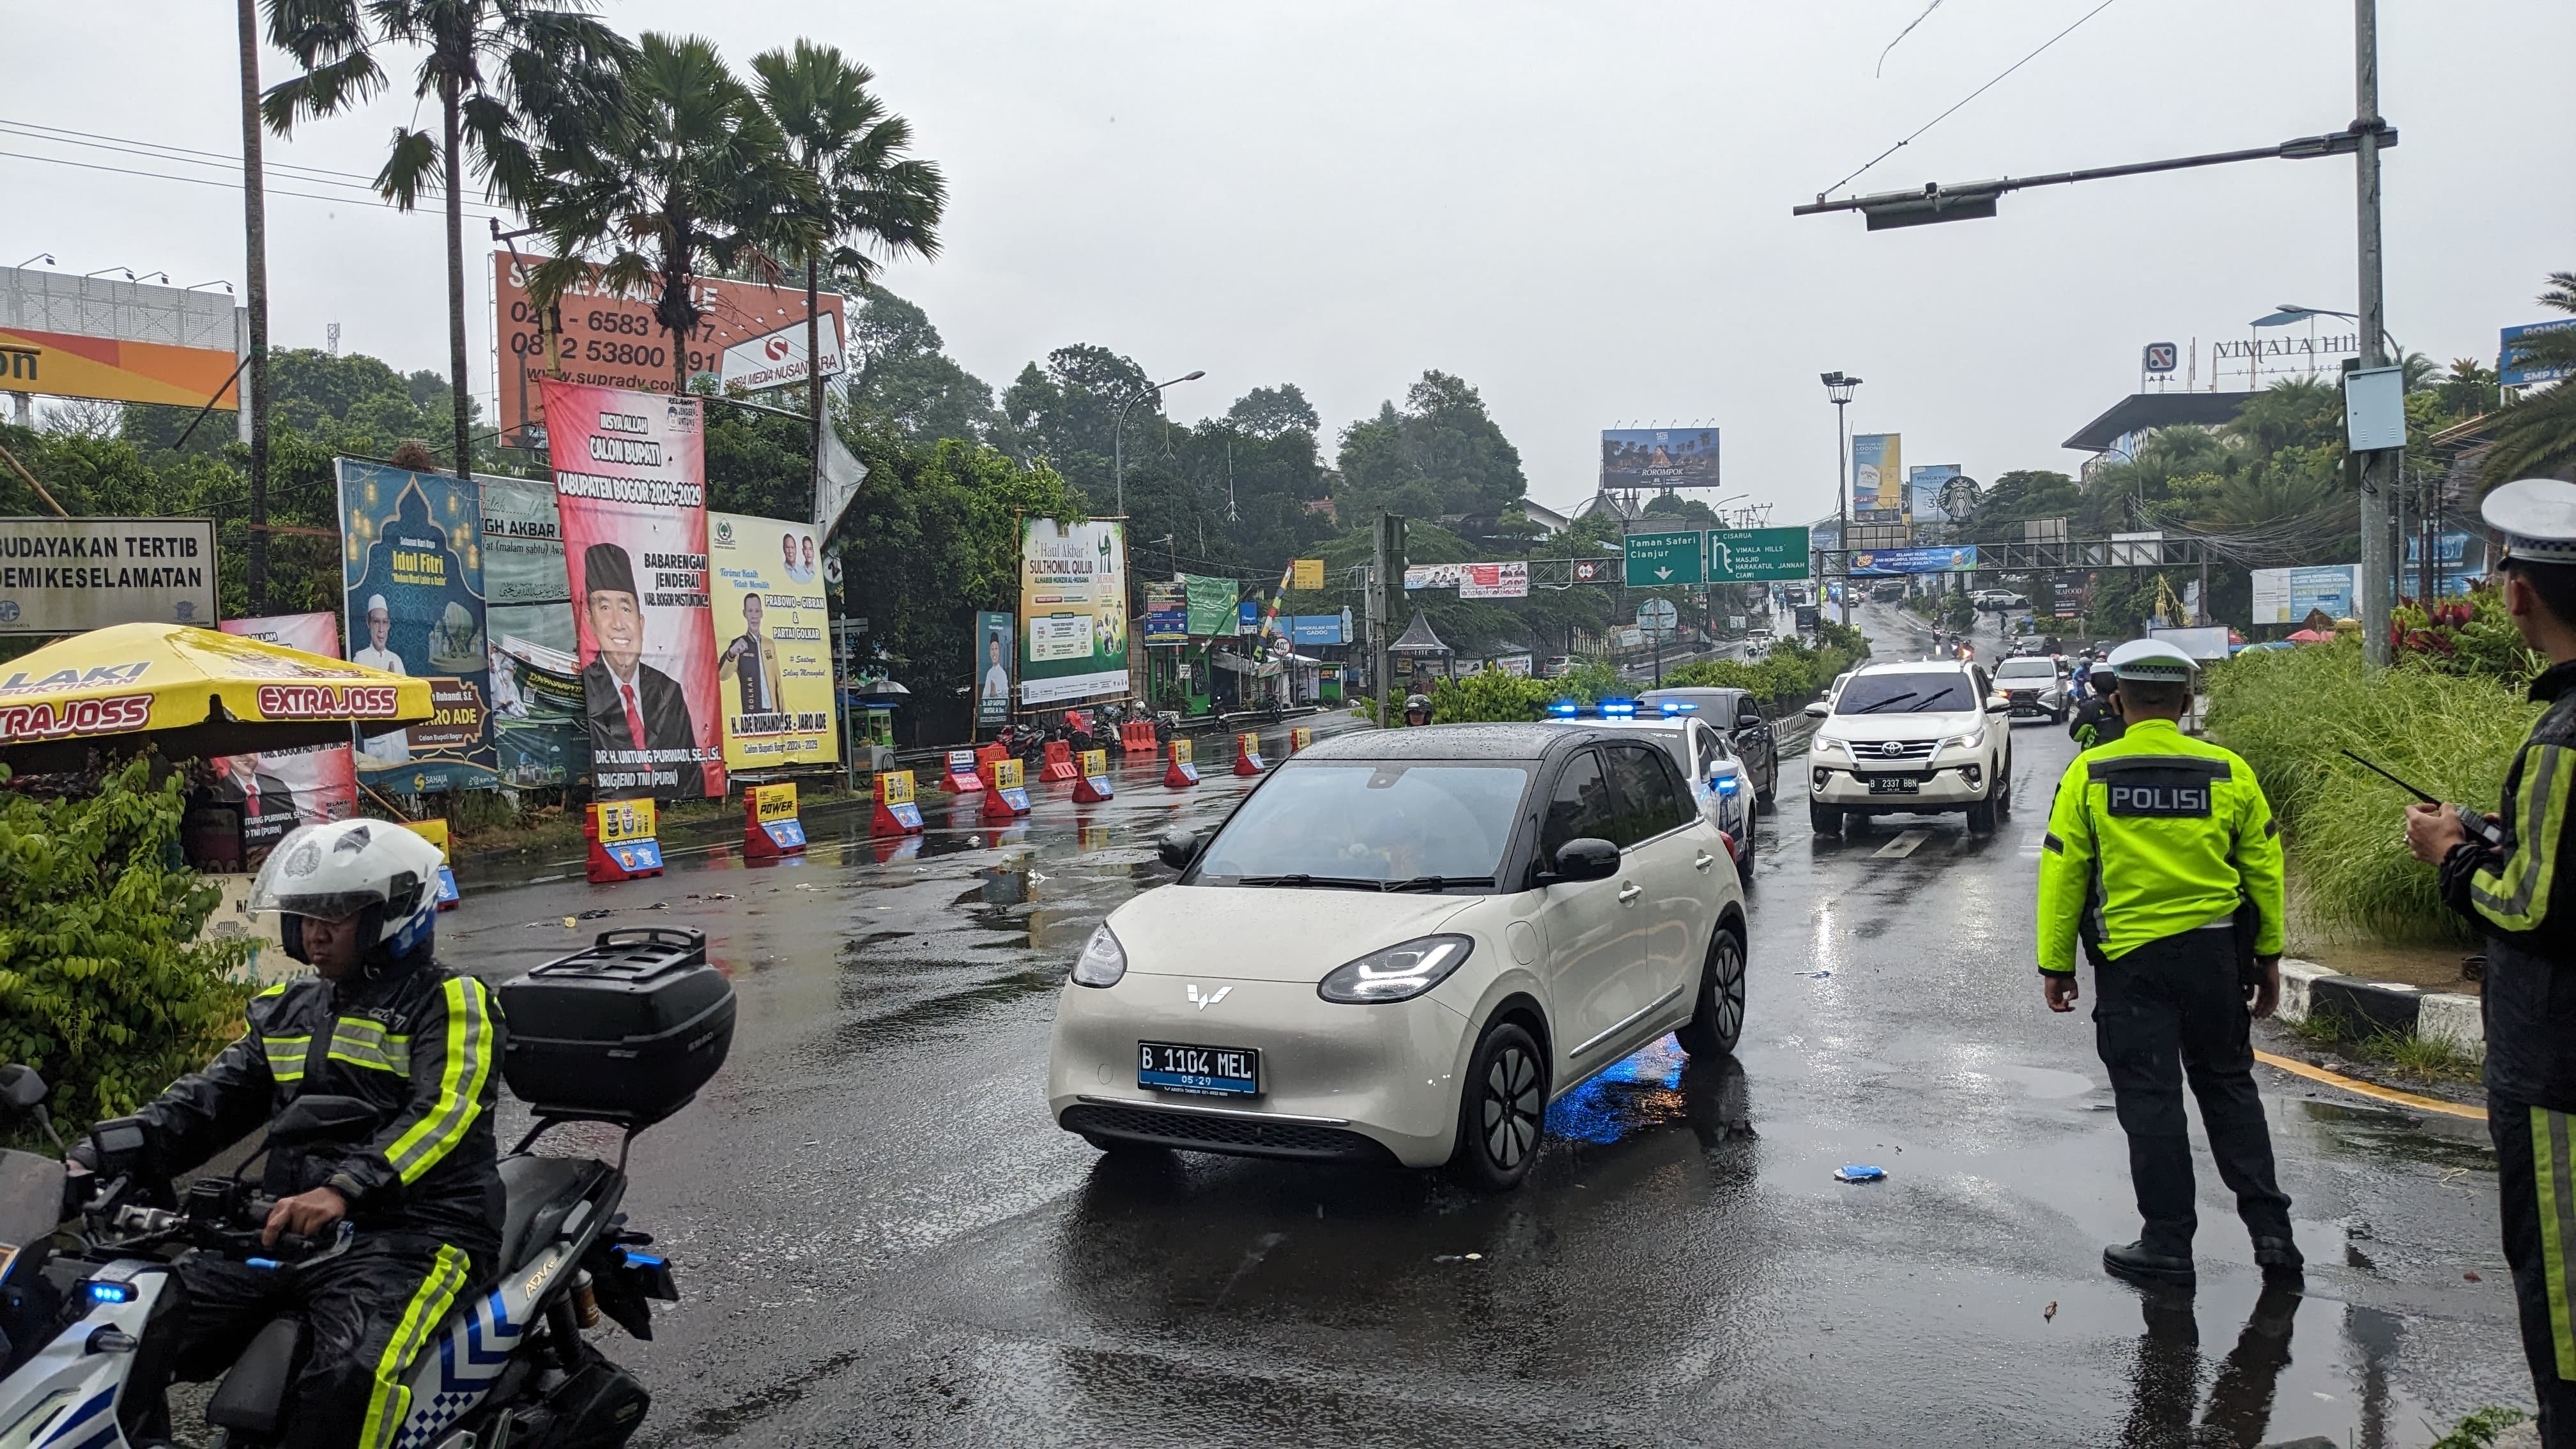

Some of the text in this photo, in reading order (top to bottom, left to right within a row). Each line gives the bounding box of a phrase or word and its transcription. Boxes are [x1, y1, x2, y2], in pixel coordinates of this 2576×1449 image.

[588, 310, 648, 336] 6583
[511, 332, 664, 368] 082 53800
[2322, 333, 2359, 353] HIL
[748, 369, 774, 387] MEDIA
[775, 353, 837, 381] NUSANARA
[2237, 367, 2275, 376] VILLA
[2312, 364, 2342, 373] RESO
[2523, 371, 2550, 381] SMP
[600, 413, 648, 434] INSYA ALLAH
[590, 436, 661, 466] CALON BUPATI
[556, 470, 702, 507] KABUPATEN BOGOR 2024-2029
[509, 521, 555, 537] AKBAR
[122, 537, 198, 558] TERTIB
[496, 539, 549, 555] (malam sabtu)
[1666, 536, 1696, 546] Safari
[1041, 542, 1084, 558] Haul Akbar
[1630, 549, 1669, 560] Cianjur
[393, 550, 444, 574] Idul Fitri
[645, 553, 706, 570] BABARENGAN
[1029, 560, 1093, 576] SULTHONUL QULUB
[0, 567, 201, 588] EMI KESELAMATAN
[656, 572, 700, 590] JENDERAL
[657, 593, 675, 607] BOGOR
[765, 594, 797, 608] PRABOWO
[802, 596, 825, 609] GIBRAN
[792, 611, 799, 624] &
[773, 627, 821, 640] PARTAI GOLKAR
[2, 661, 152, 689] LAKI
[261, 688, 397, 712] EXTRA JOSS
[435, 691, 473, 702] Ruhandi, S.E.
[58, 697, 149, 730] JOSS
[453, 708, 477, 725] ADE
[731, 716, 739, 735] H.
[740, 714, 753, 735] ADE
[784, 714, 793, 733] SE
[798, 712, 814, 733] JARO
[814, 711, 827, 732] ADE
[787, 740, 801, 751] 2024
[595, 749, 610, 764] DR.
[610, 749, 618, 764] H.
[618, 749, 652, 764] UNTUNG
[654, 748, 692, 764] PURWADI,
[425, 774, 447, 785] SAHAJA
[597, 769, 678, 790] BRIGJEND TNI (PURN)
[1870, 779, 1917, 788] B 2337 BBN
[2112, 787, 2207, 810] POLISI
[760, 801, 793, 816] POWER
[1142, 1046, 1252, 1079] B 1104 MEL
